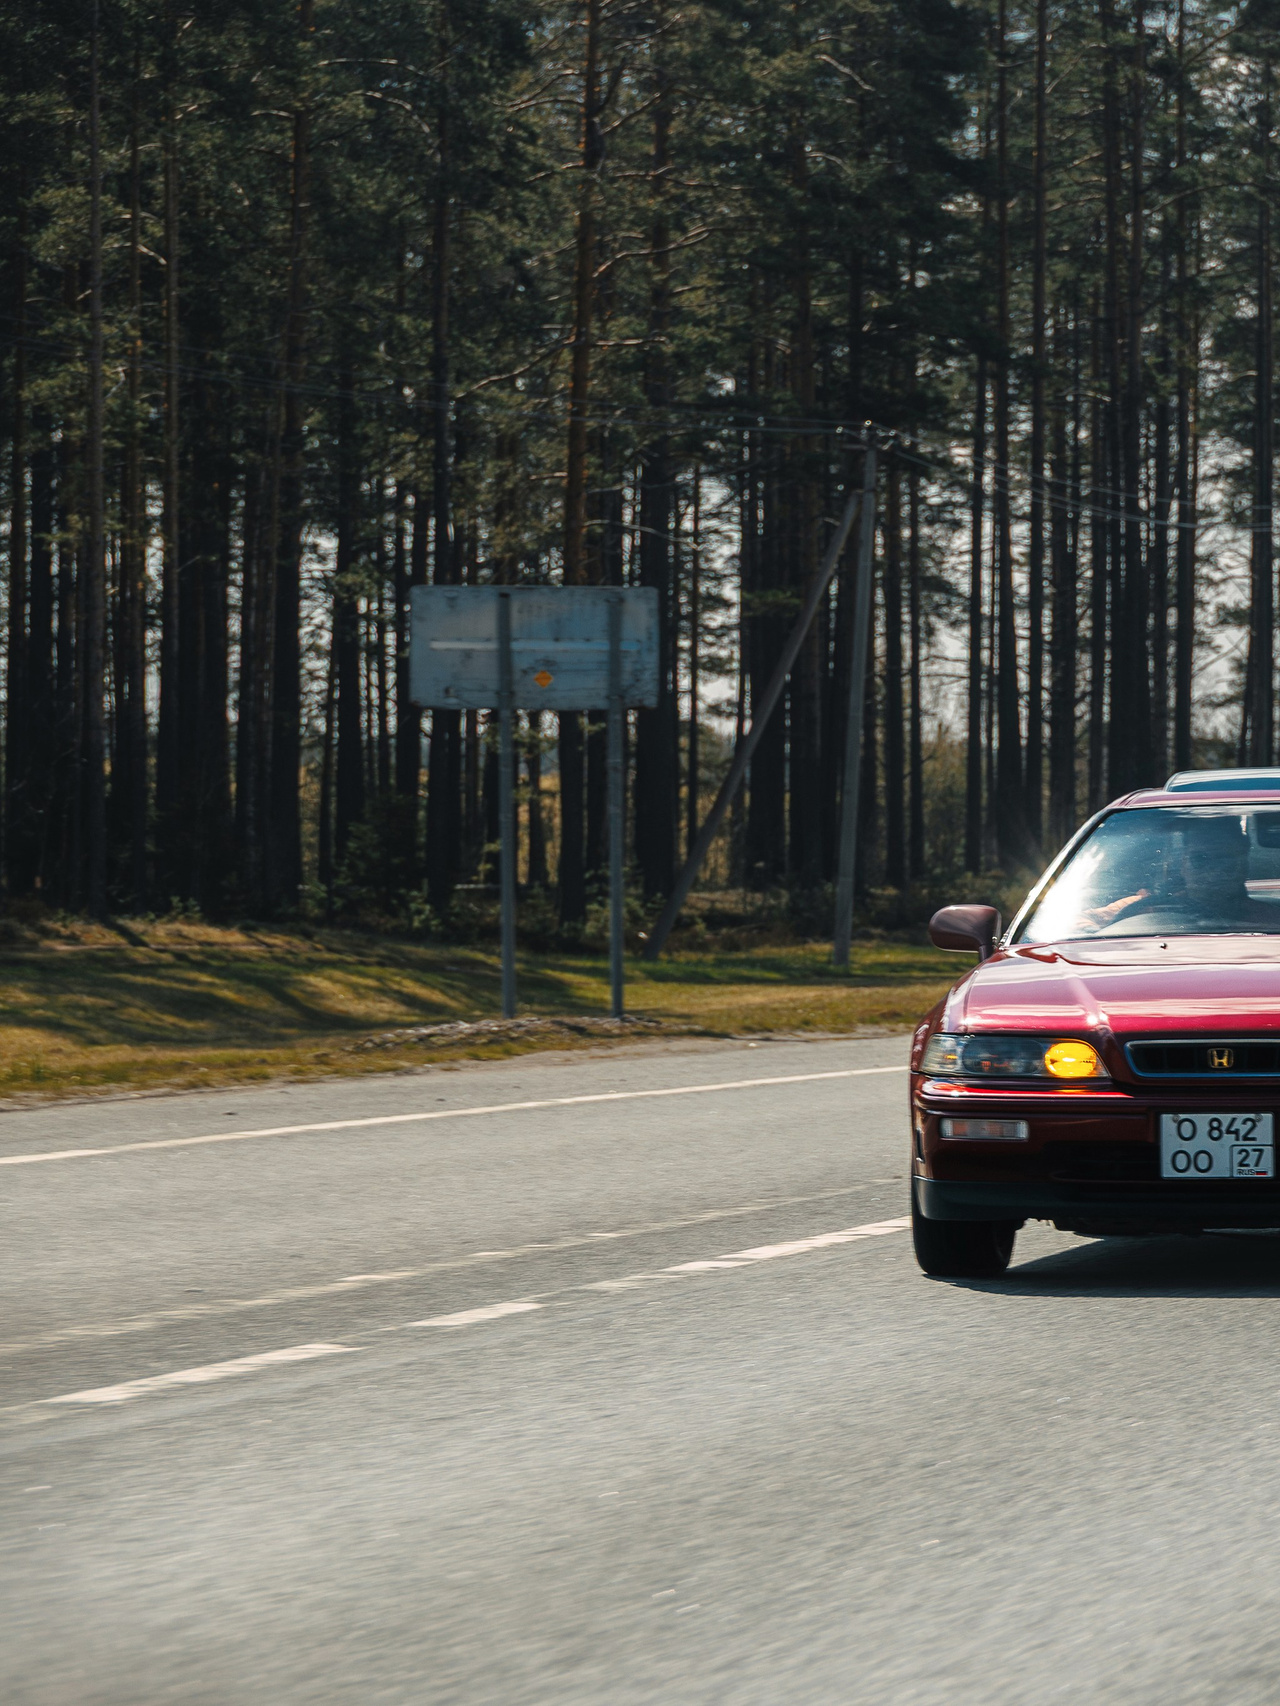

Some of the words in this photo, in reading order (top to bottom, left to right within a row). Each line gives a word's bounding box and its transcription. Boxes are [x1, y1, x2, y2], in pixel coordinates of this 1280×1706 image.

[1208, 1117, 1257, 1141] 842
[1237, 1148, 1264, 1167] 27
[1236, 1168, 1255, 1176] RUS
